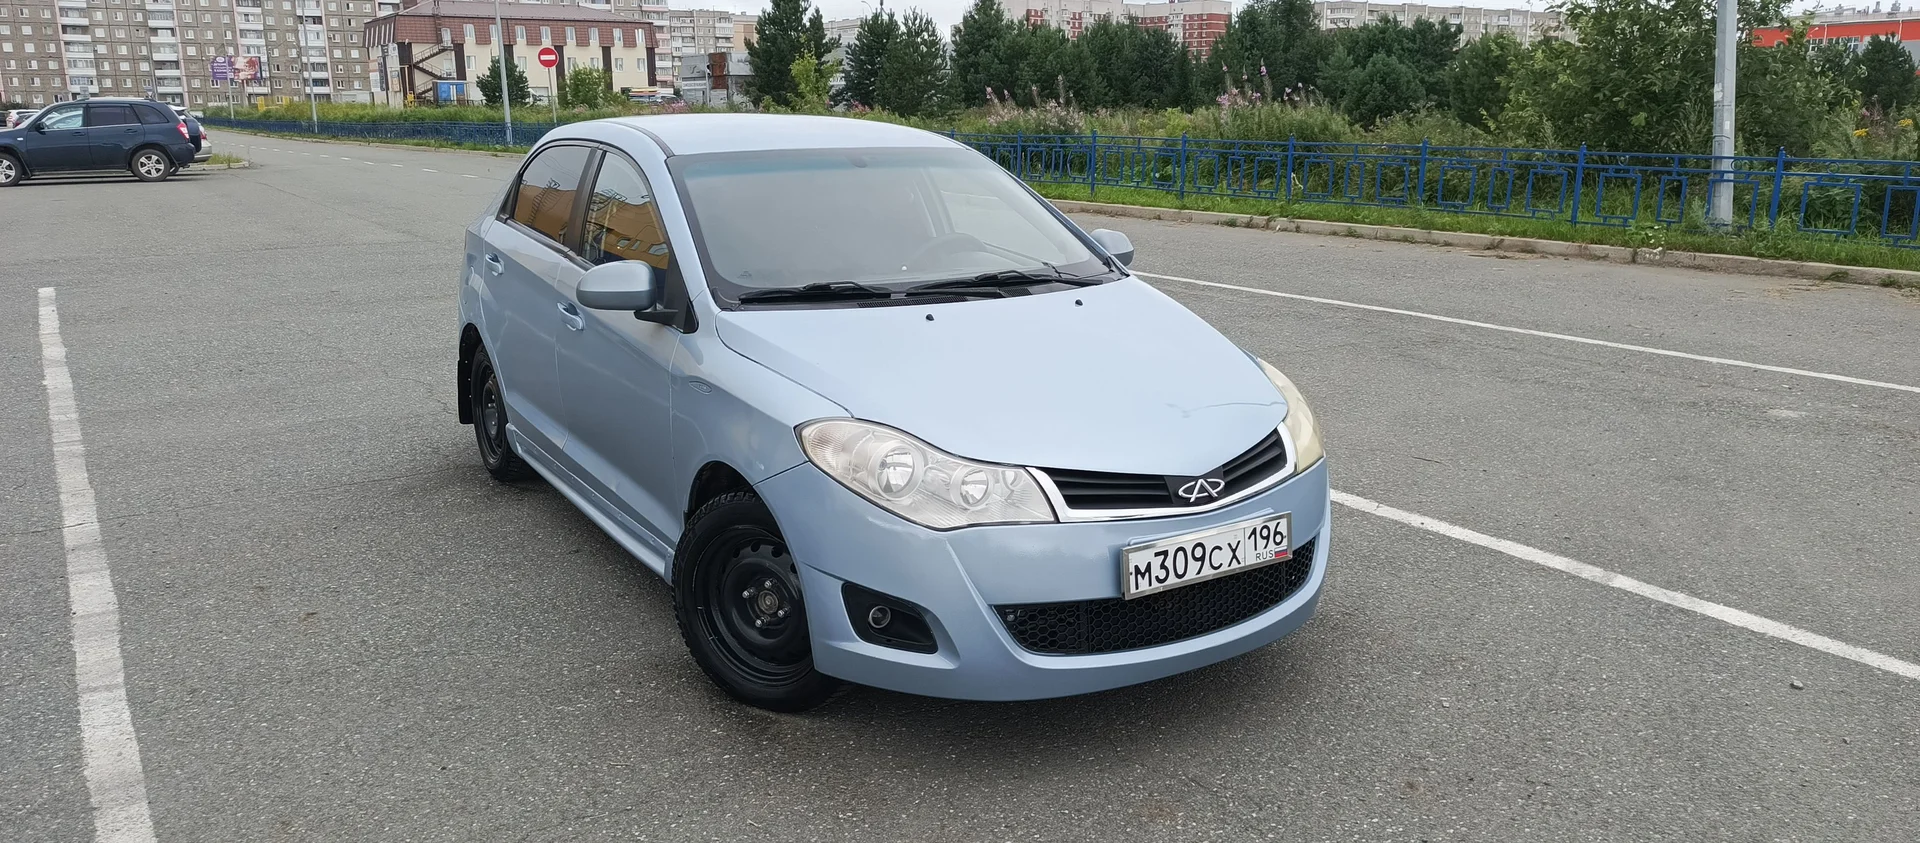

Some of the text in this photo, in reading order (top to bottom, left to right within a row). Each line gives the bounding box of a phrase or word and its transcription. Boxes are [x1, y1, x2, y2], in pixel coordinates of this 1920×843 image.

[1134, 521, 1284, 590] М309СХ 196
[1255, 549, 1274, 561] RUS
